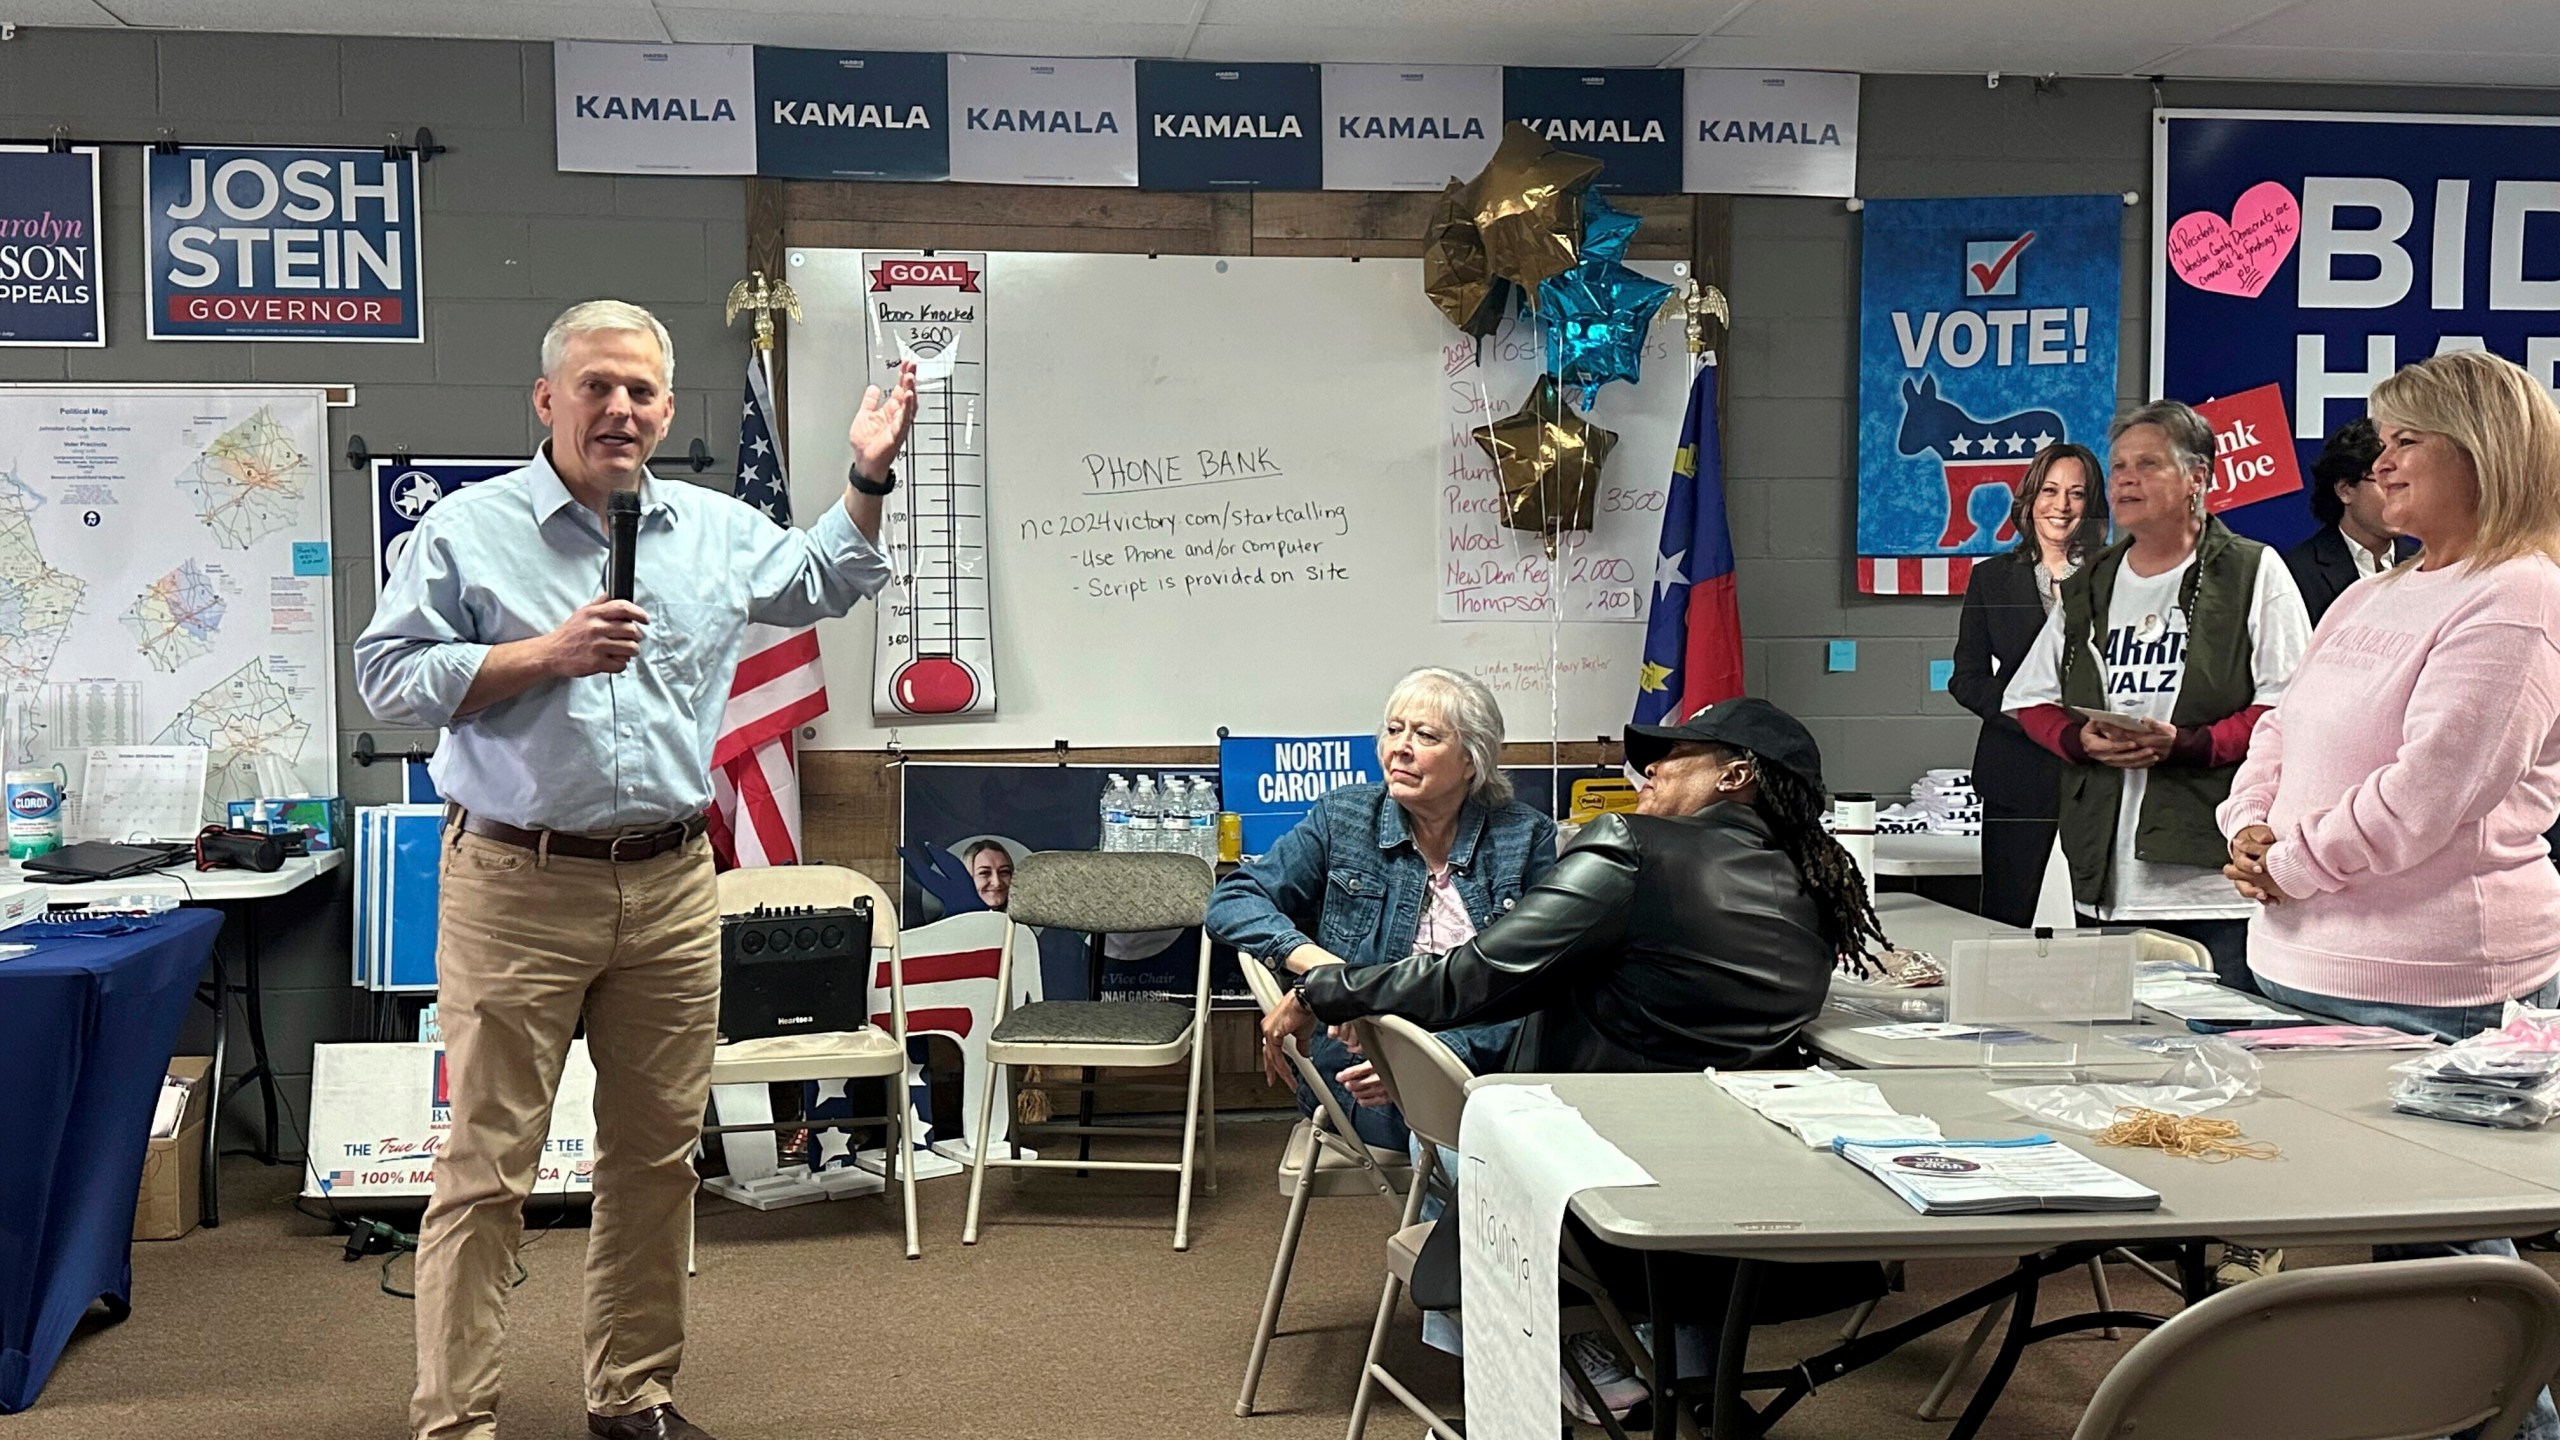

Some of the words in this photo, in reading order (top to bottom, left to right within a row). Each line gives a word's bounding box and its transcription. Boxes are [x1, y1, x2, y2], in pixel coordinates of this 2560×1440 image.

[576, 95, 736, 121] KAMALA
[774, 101, 931, 129] KAMALA
[967, 107, 1118, 134] KAMALA
[1153, 114, 1303, 138] KAMALA
[1338, 116, 1485, 140] KAMALA
[1699, 120, 1841, 146] KAMALA
[166, 158, 399, 223] JOSH
[167, 226, 402, 290] STEIN
[890, 265, 963, 281] GOAL
[189, 299, 382, 321] GOVERNOR
[920, 304, 975, 320] Knocked
[910, 327, 953, 344] 3600
[1892, 306, 2089, 368] VOTE!
[92, 408, 108, 416] Map
[2215, 419, 2262, 456] nk
[1082, 454, 1183, 489] PHONE
[1197, 447, 1282, 479] BANK
[2221, 454, 2275, 493] Joe
[1603, 487, 1666, 512] 3500
[1185, 538, 1236, 560] and/or
[1449, 523, 1504, 552] Wood
[1089, 578, 1148, 602] Script
[1158, 574, 1176, 590] is
[1185, 566, 1264, 596] provided
[1271, 569, 1294, 584] on
[1306, 563, 1350, 581] site
[1446, 561, 1481, 587] New
[1481, 560, 1516, 585] Dem
[1571, 556, 1634, 583] 2000
[887, 635, 909, 646] 360
[1275, 741, 1350, 772] NORTH
[15, 797, 48, 809] CLOROX
[1138, 972, 1176, 984] Chair
[777, 1015, 813, 1026] Heartsea
[344, 1144, 372, 1156] THE
[379, 1137, 418, 1155] True
[557, 1139, 584, 1152] TEE
[361, 1171, 404, 1184] 100%
